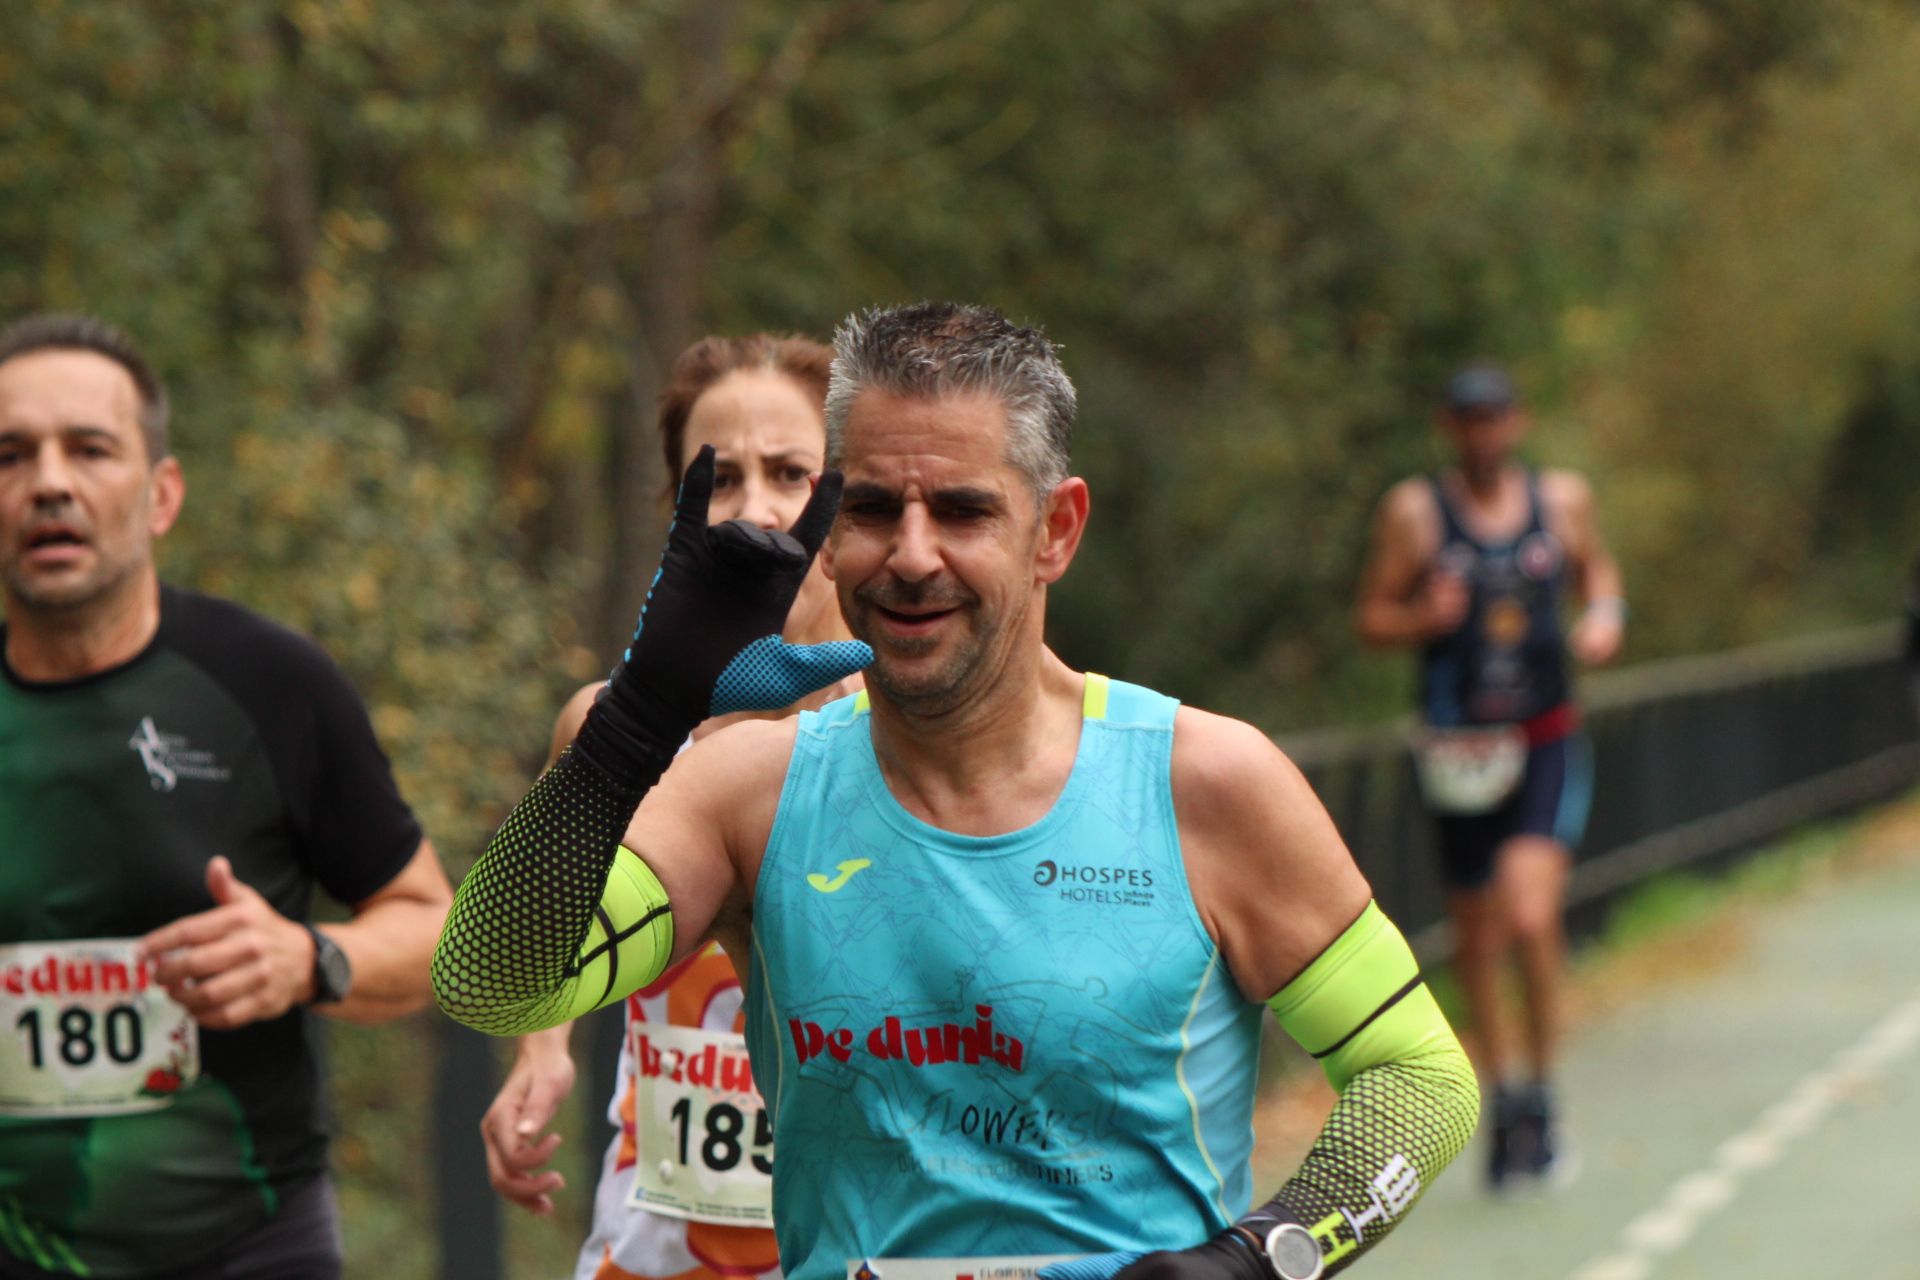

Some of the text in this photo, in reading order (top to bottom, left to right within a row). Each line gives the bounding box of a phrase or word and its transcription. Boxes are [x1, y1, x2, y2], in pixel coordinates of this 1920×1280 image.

[1060, 887, 1122, 905] HOTELS
[1061, 865, 1153, 887] HOSPES
[16, 1003, 143, 1070] 180
[671, 1098, 773, 1174] 185
